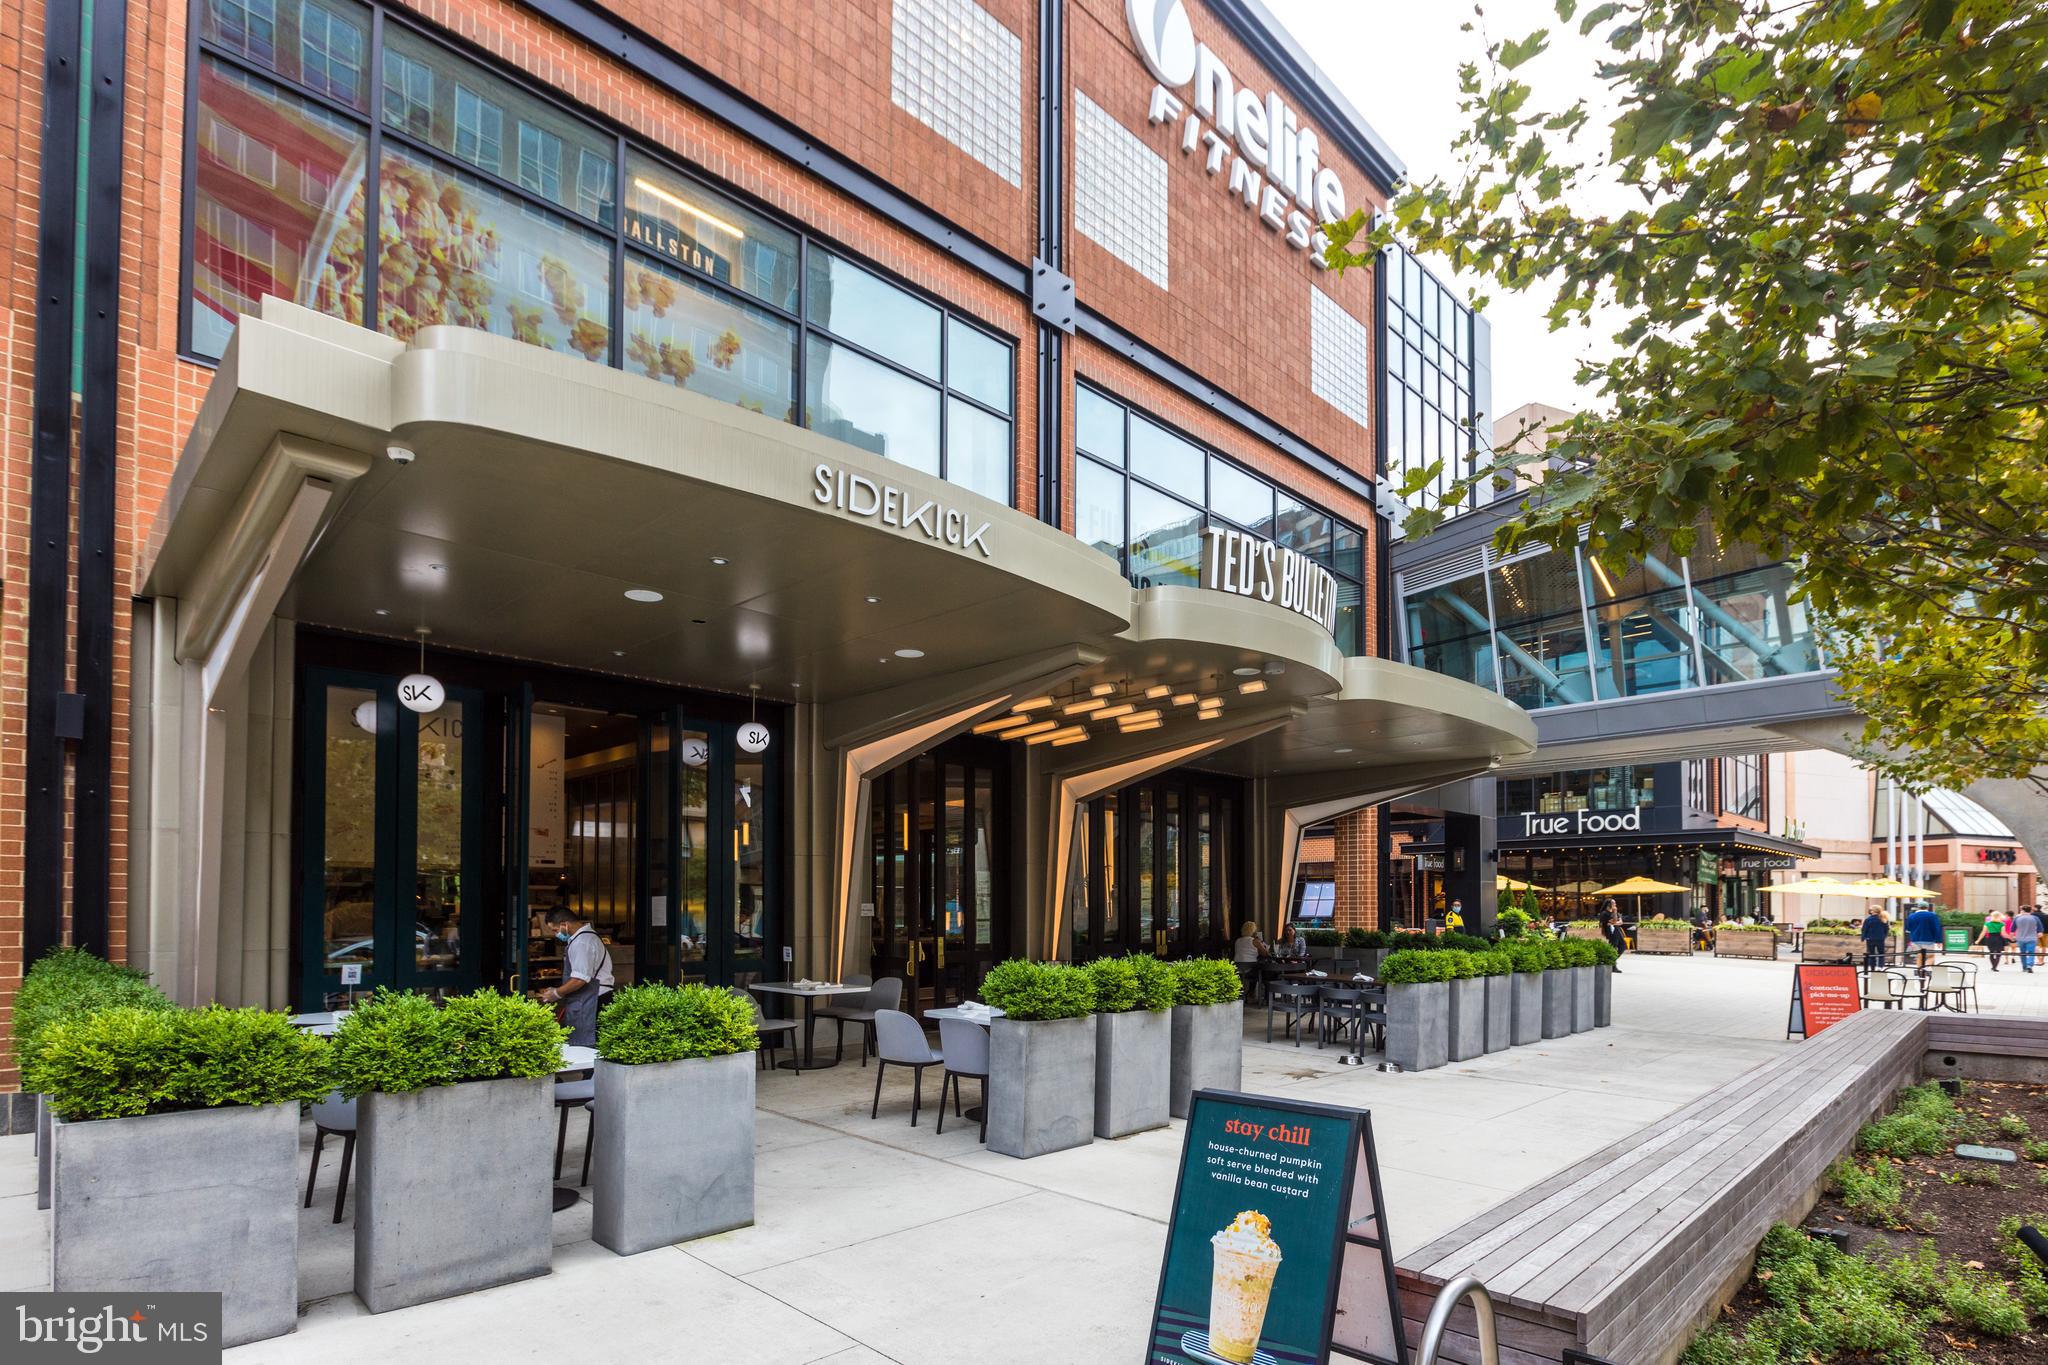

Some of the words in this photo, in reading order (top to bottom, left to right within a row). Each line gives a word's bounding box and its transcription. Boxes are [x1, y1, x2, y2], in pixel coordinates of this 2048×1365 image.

[624, 215, 714, 276] ALLSTON
[814, 463, 992, 556] SIDEKICK
[1207, 526, 1276, 602] TED'S
[1280, 548, 1338, 637] BULLETIN
[403, 685, 432, 701] SK
[749, 731, 768, 745] SK
[1521, 812, 1569, 836] True
[1578, 805, 1640, 834] Food
[1741, 858, 1760, 868] True
[1763, 857, 1791, 868] Food
[1225, 1119, 1264, 1141] stay
[1268, 1124, 1310, 1146] chill
[1208, 1141, 1277, 1160] house-churned
[1279, 1156, 1322, 1169] pumpkin
[1207, 1156, 1225, 1166] soft
[1227, 1161, 1252, 1171] serve
[1254, 1164, 1295, 1179] blended
[1297, 1173, 1319, 1185] with
[1211, 1171, 1242, 1184] vanilla
[1244, 1177, 1268, 1189] bean
[1271, 1184, 1309, 1198] custard
